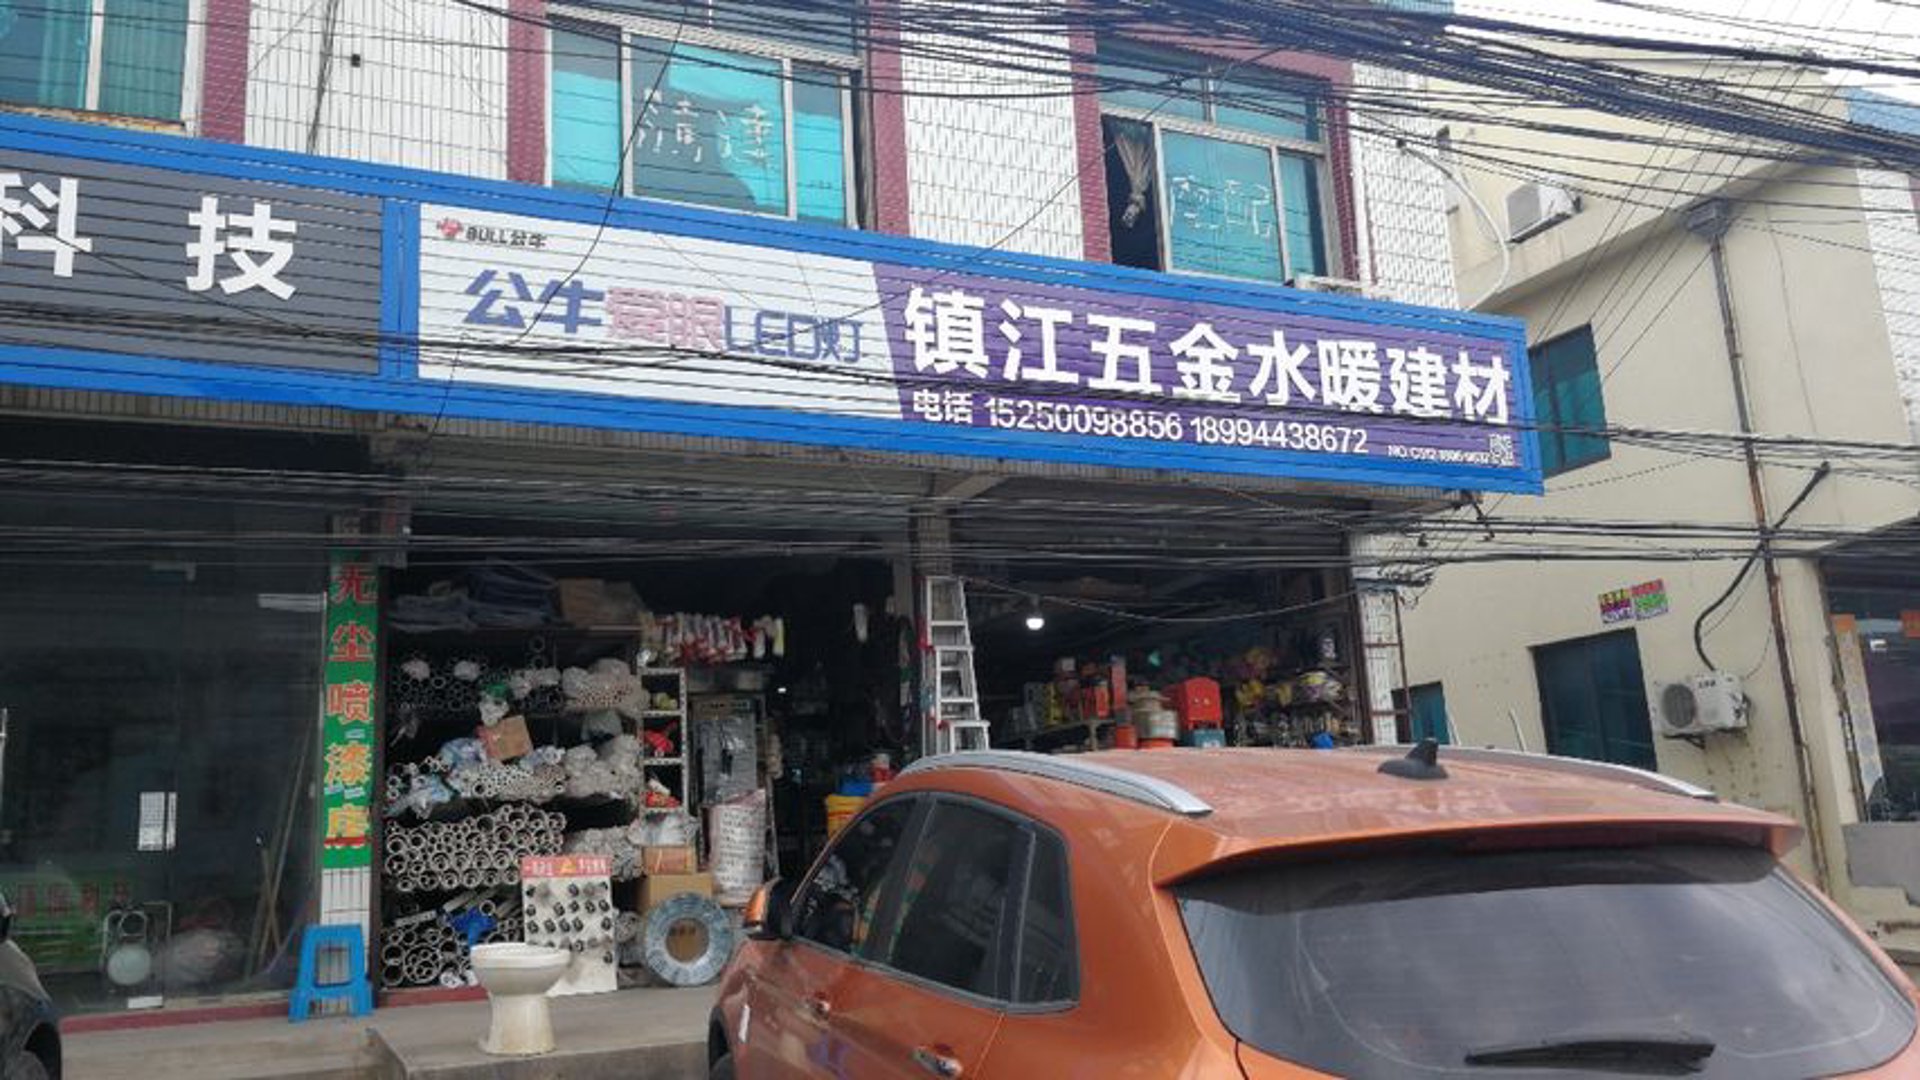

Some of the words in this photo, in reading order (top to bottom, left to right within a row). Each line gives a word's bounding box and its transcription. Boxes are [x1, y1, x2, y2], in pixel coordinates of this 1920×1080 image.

[904, 285, 1510, 425] 镇江五金水暖建材
[913, 388, 973, 424] 电话
[984, 398, 1183, 440] 15250098856
[1190, 416, 1370, 454] 18994438672
